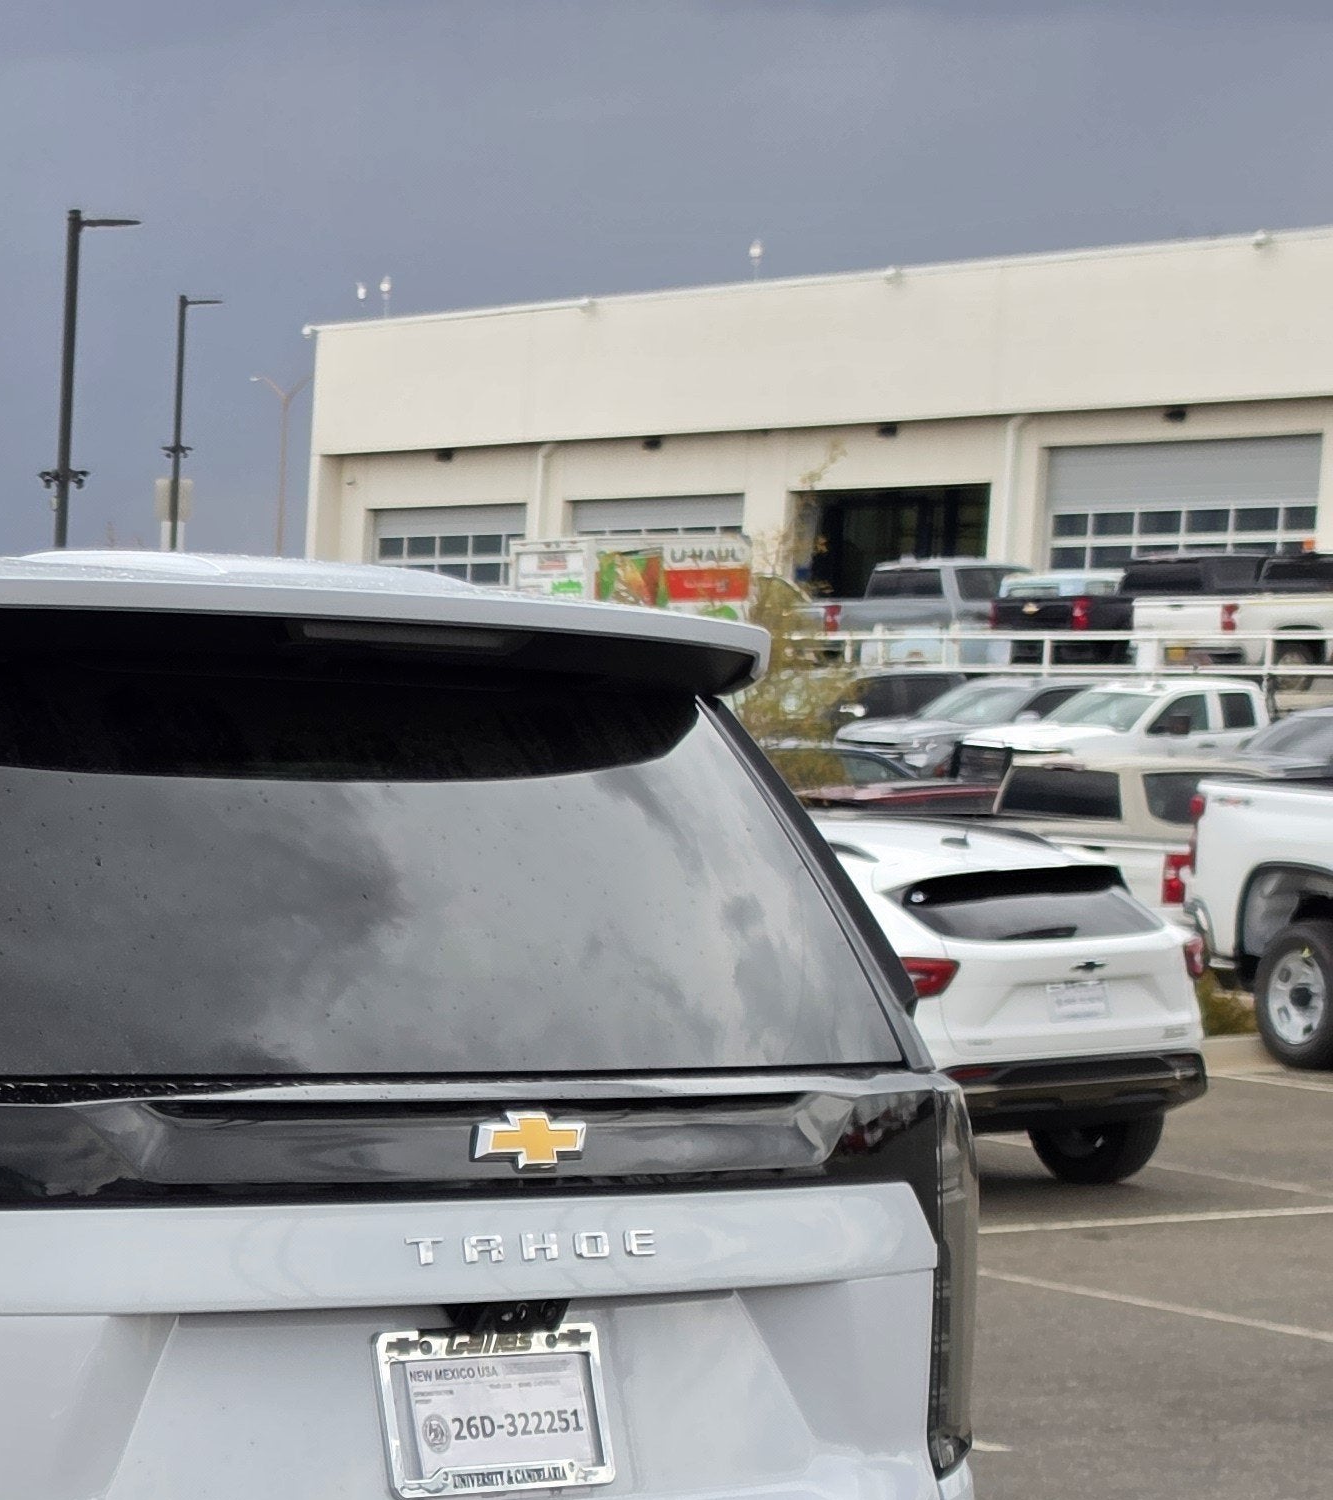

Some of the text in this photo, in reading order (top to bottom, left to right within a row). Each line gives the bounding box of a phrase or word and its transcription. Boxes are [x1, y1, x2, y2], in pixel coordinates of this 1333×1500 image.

[405, 1229, 657, 1266] TAHOE
[409, 1370, 432, 1383] NEW
[435, 1367, 476, 1381] MEXICO
[477, 1365, 499, 1378] USA
[451, 1408, 584, 1441] 26D-322251
[452, 1470, 504, 1490] UNIVERSITY
[506, 1469, 515, 1486] &
